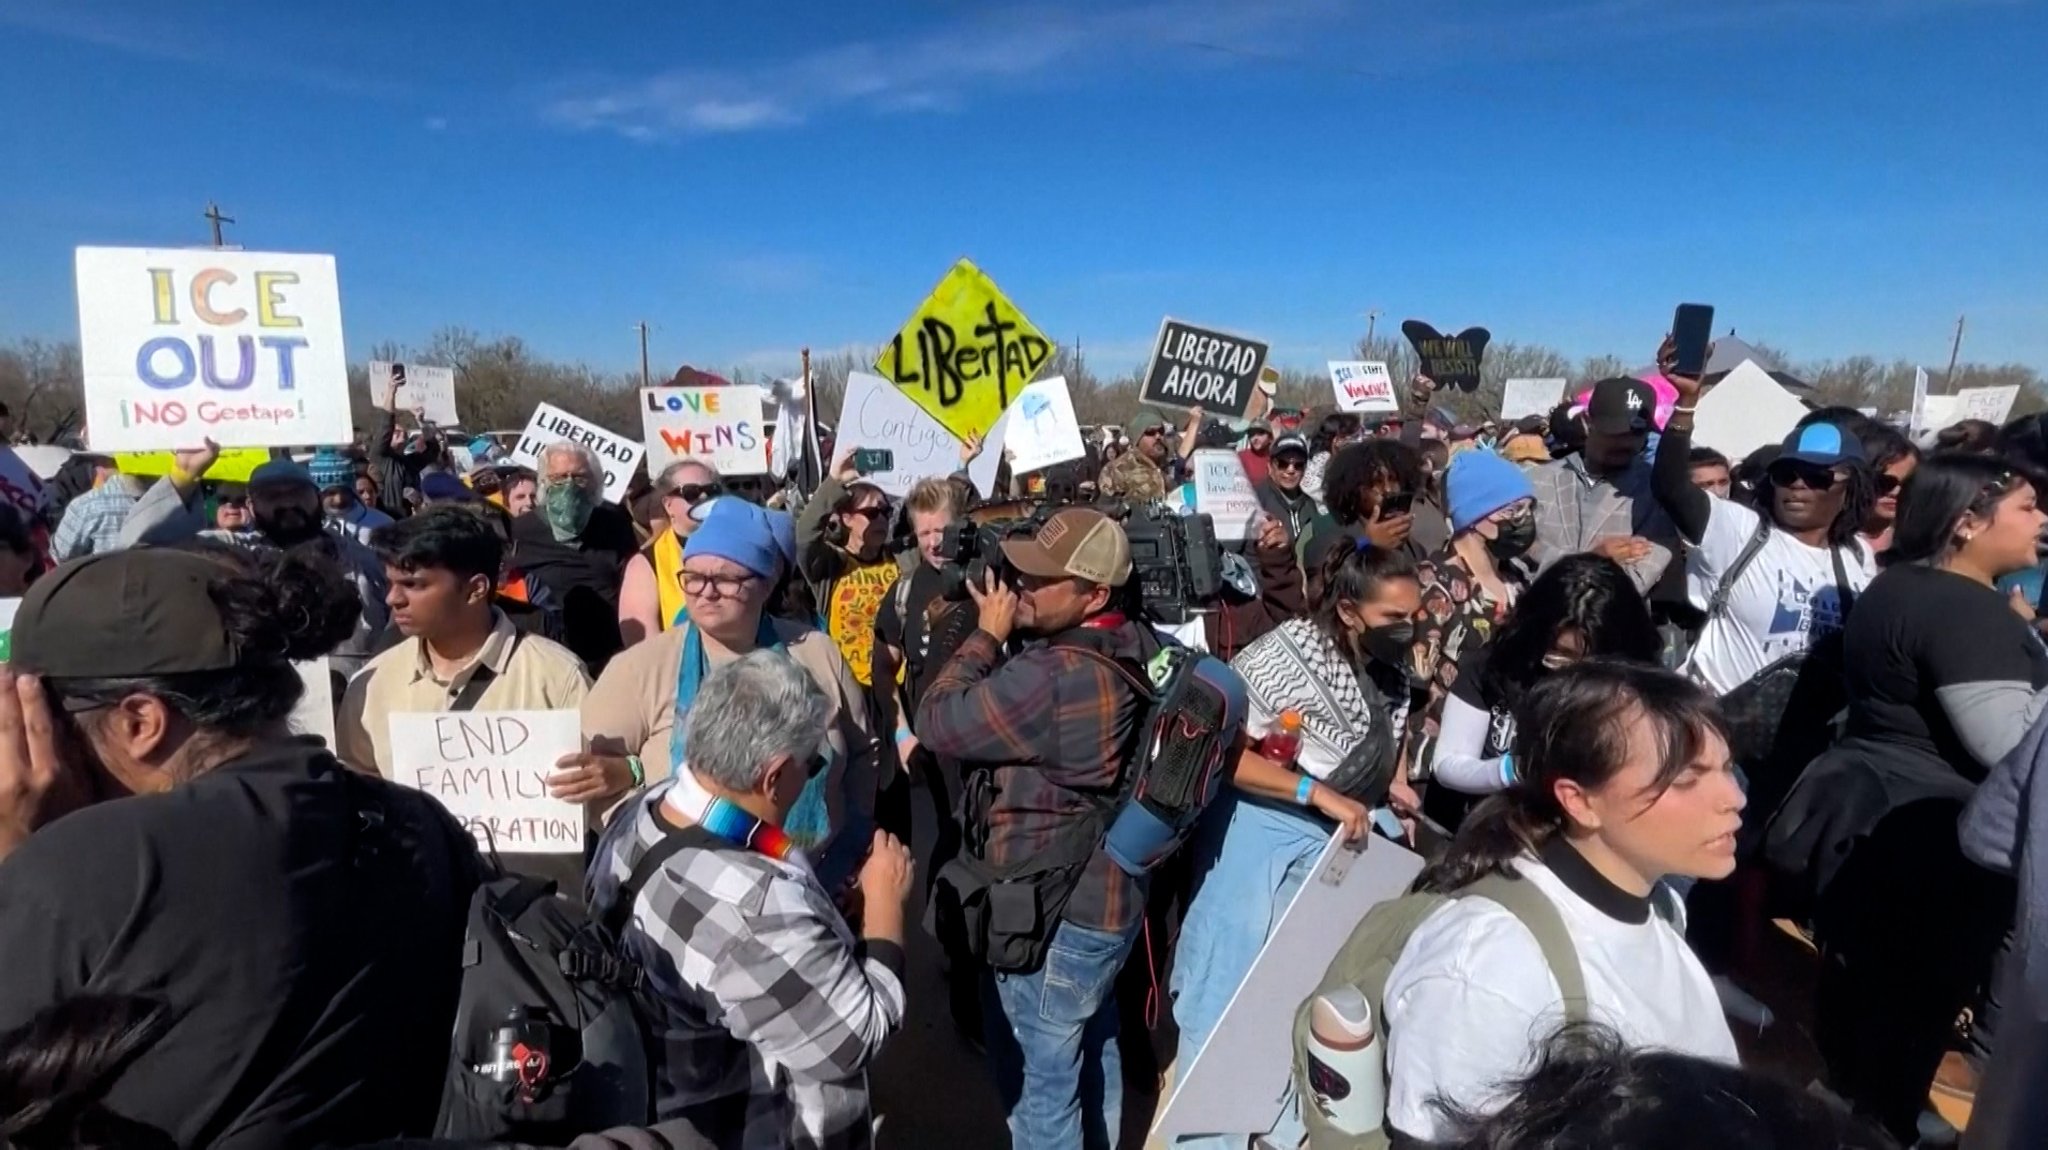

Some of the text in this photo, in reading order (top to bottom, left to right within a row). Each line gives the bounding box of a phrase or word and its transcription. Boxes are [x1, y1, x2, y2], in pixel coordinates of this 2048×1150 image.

[147, 267, 303, 327] ICE
[136, 334, 309, 390] OUT
[1162, 329, 1256, 376] LIBERTAD
[647, 391, 721, 414] LOVE
[1162, 365, 1238, 407] AHORA
[1626, 388, 1643, 409] LA
[197, 400, 306, 426] Gestapo!
[536, 412, 633, 463] LIBERTAD
[660, 421, 756, 455] WINS
[435, 716, 529, 762] END
[416, 766, 551, 800] FAMILY
